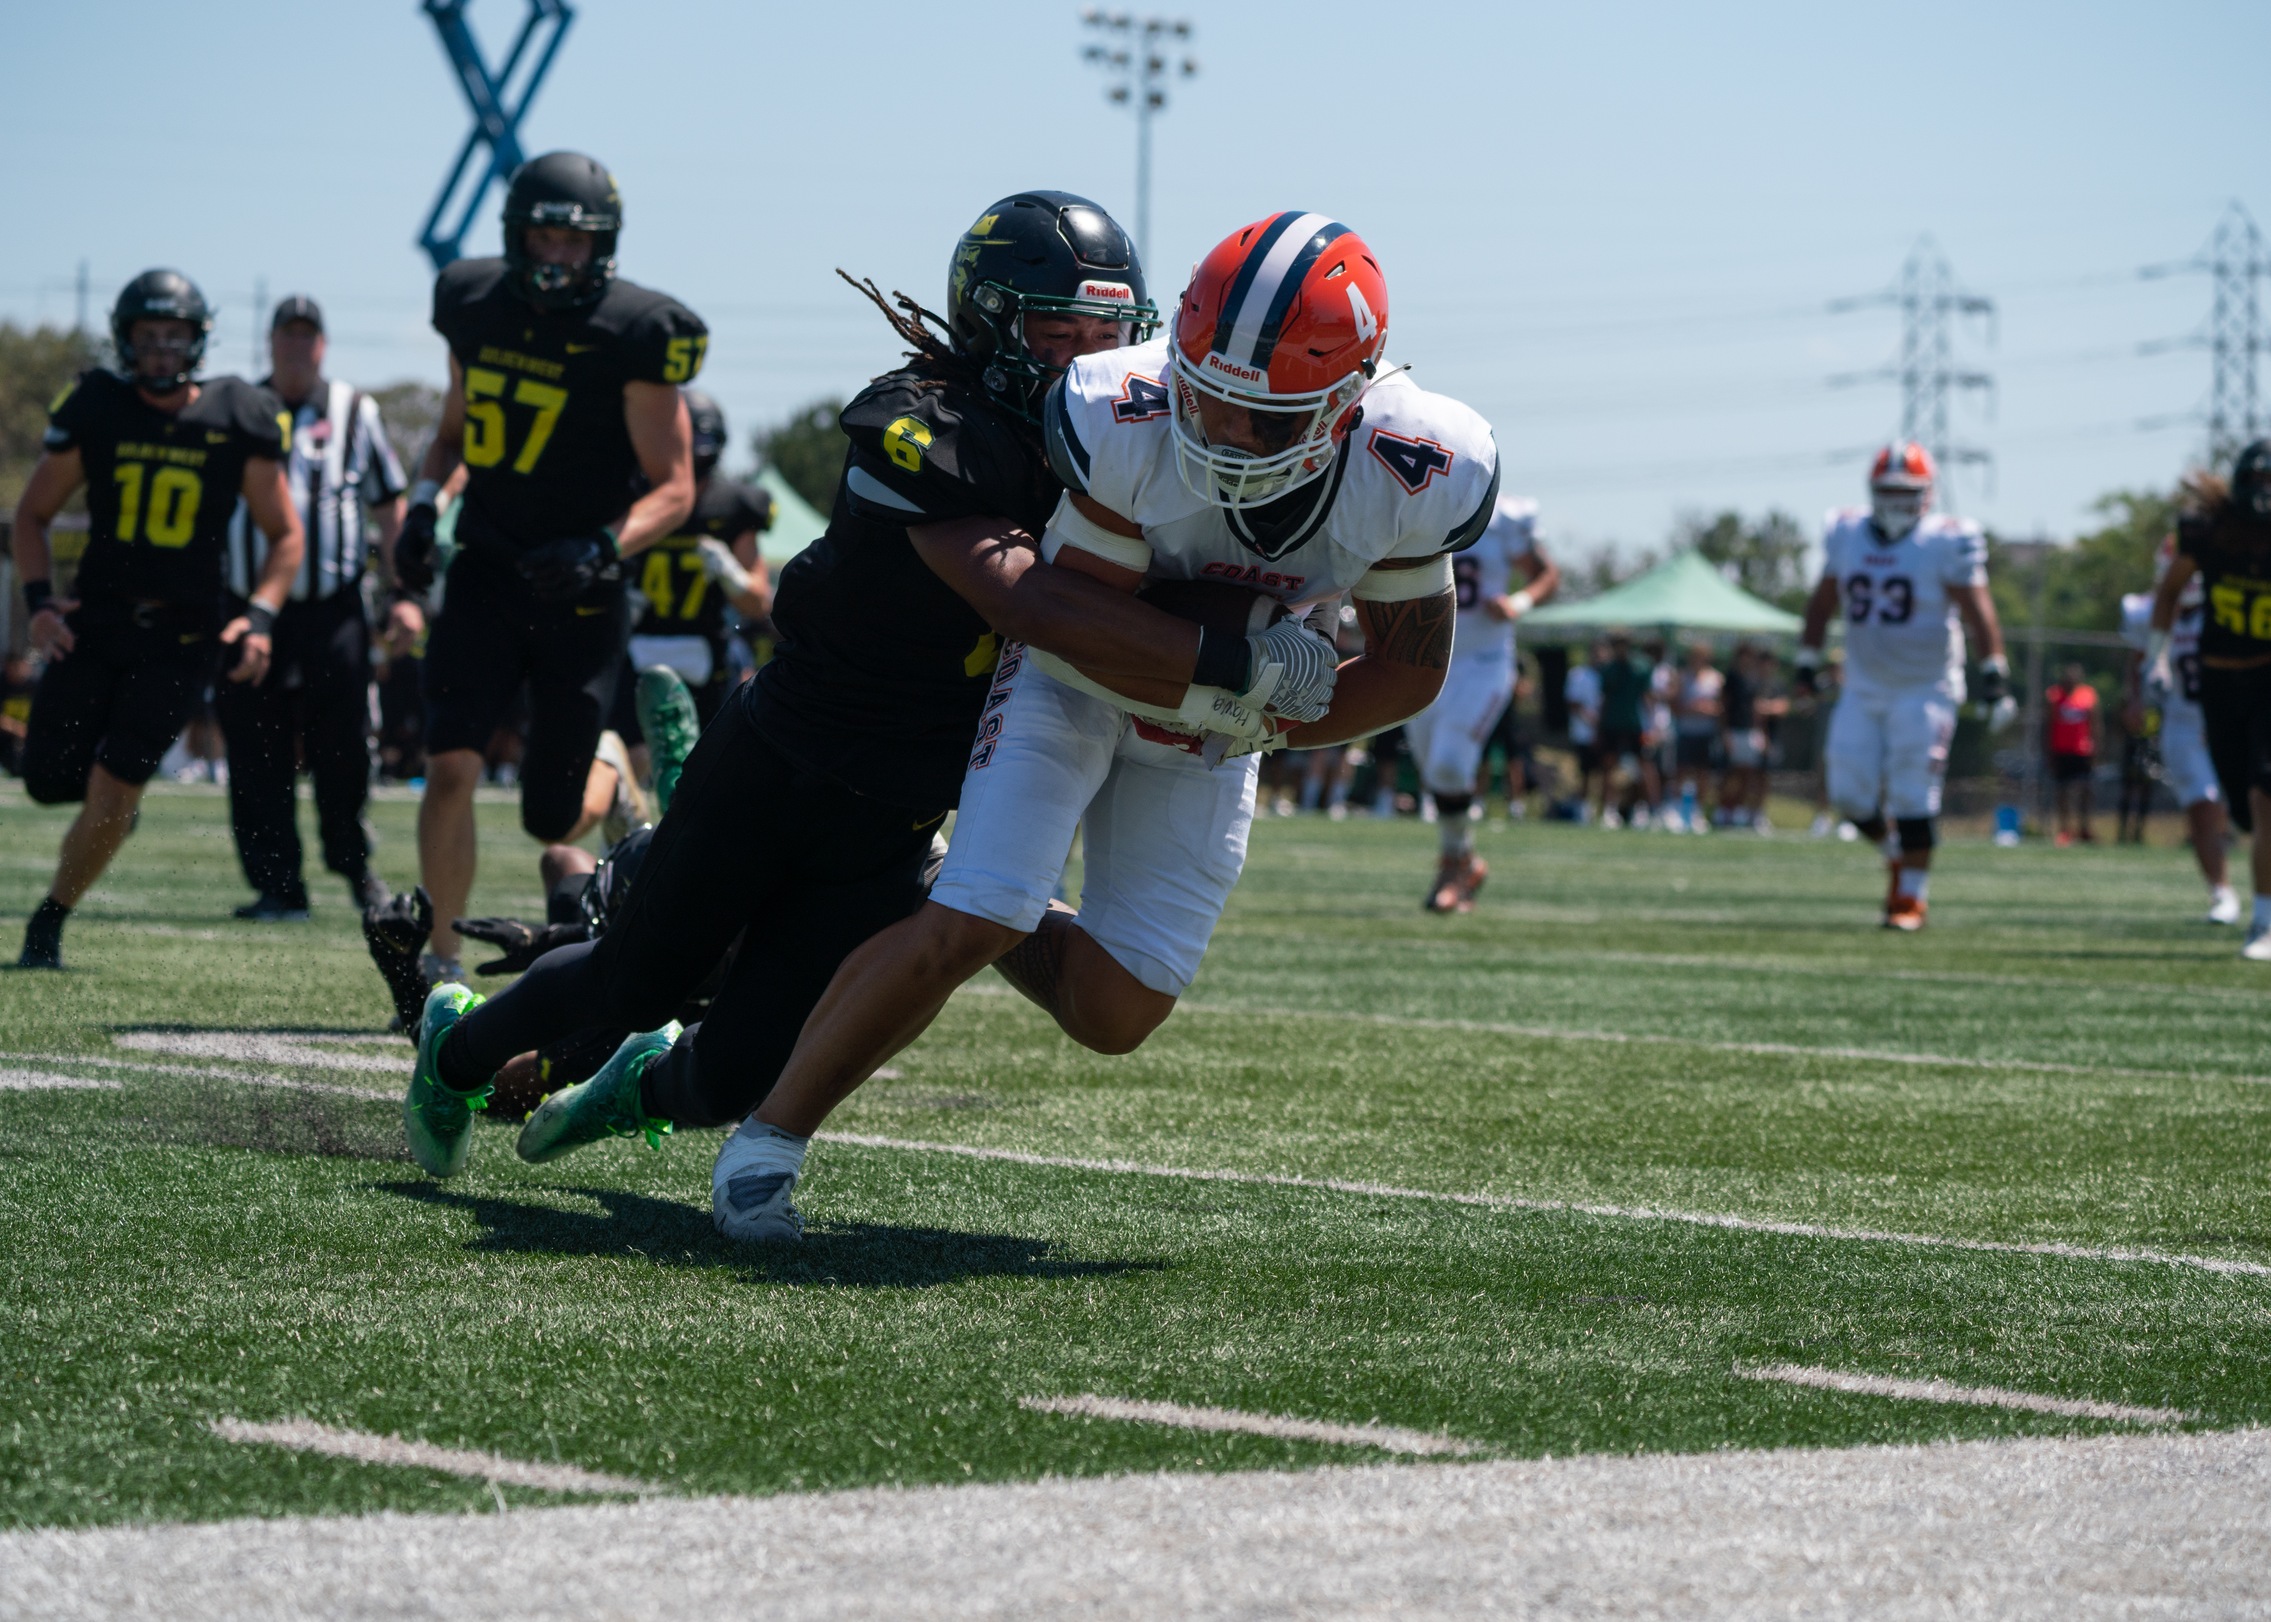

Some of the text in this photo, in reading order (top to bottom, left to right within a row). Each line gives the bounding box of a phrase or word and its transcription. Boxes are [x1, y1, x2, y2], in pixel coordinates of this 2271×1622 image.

[1086, 285, 1129, 299] Riddell
[1345, 281, 1378, 344] 4
[1110, 371, 1173, 424] 4
[1209, 355, 1261, 383] Riddell
[464, 366, 569, 475] 57
[881, 413, 936, 476] 6
[1366, 427, 1454, 496] 4
[114, 462, 203, 549] 10
[642, 551, 707, 619] 47
[1200, 562, 1305, 591] COAST
